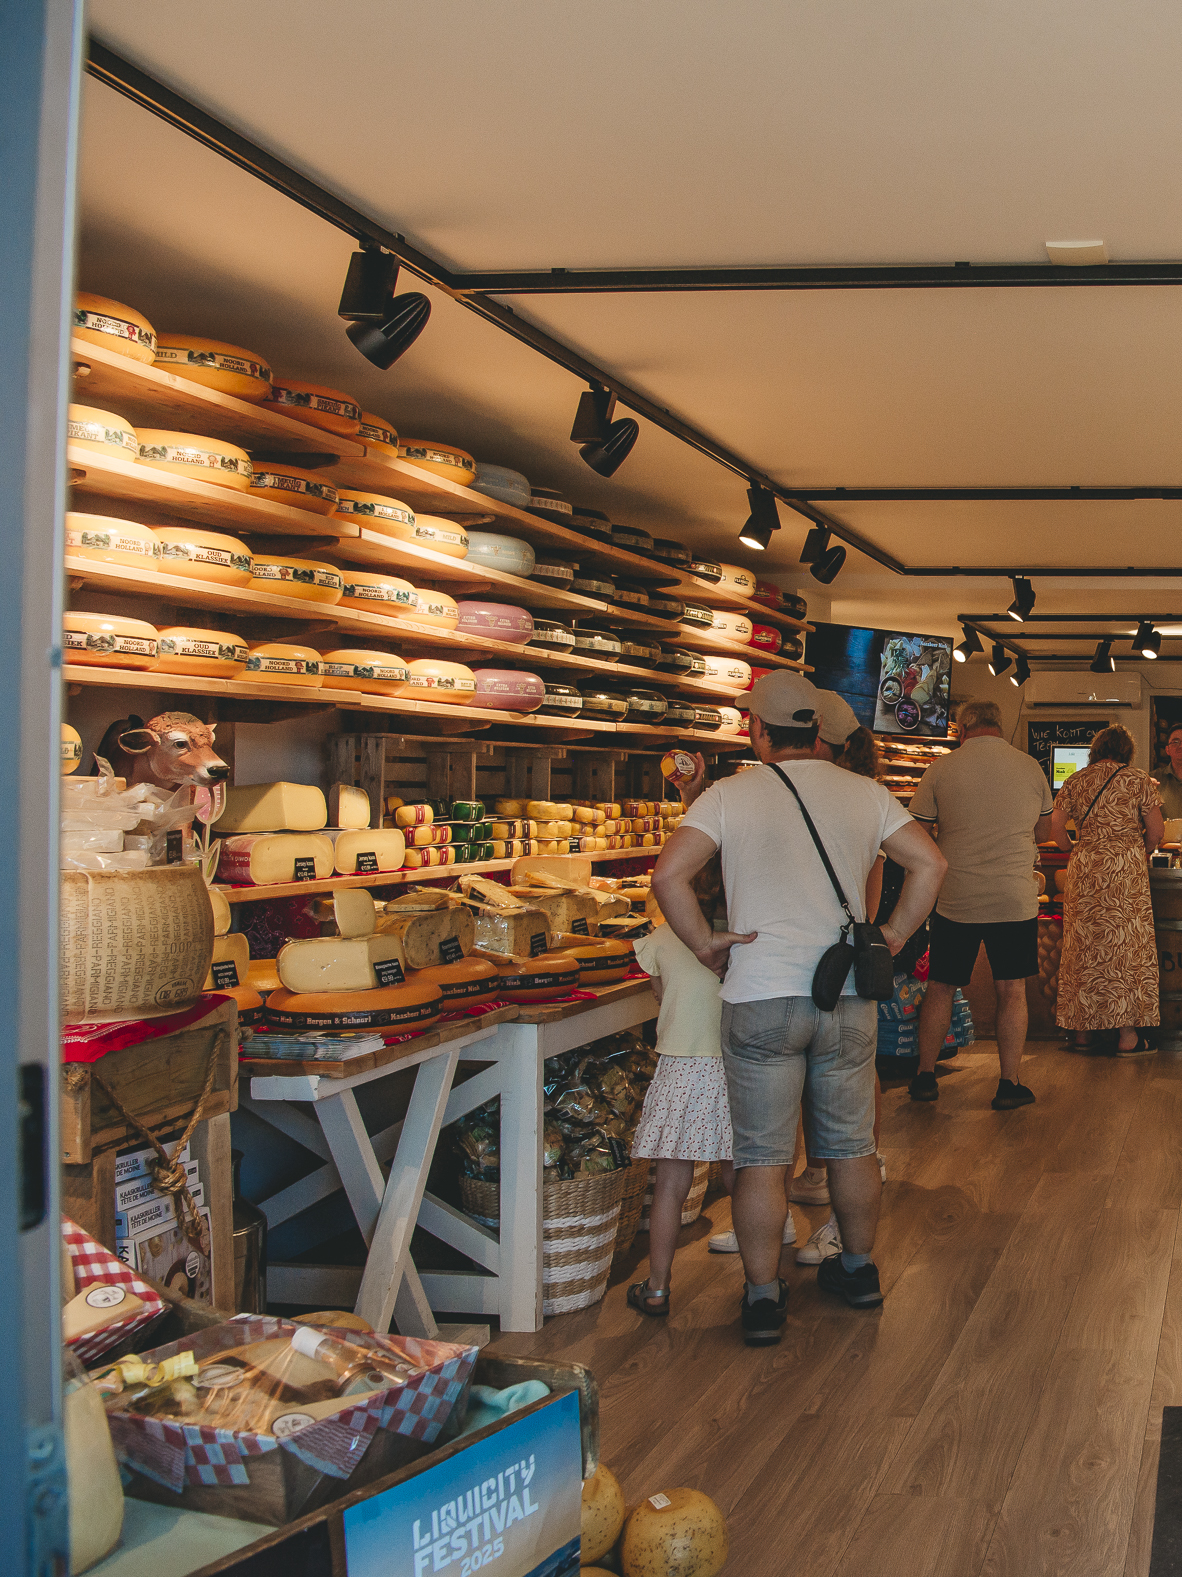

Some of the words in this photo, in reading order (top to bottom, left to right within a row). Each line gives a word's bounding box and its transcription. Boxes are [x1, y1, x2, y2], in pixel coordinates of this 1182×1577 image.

[223, 357, 245, 367] NOORD
[219, 363, 248, 373] HOLLAND
[172, 456, 205, 465] HOLLAND
[119, 538, 142, 546] NOORD
[443, 534, 457, 542] MILD
[115, 543, 144, 553] HOLLAND
[195, 553, 229, 564] KLASSIEK
[207, 550, 223, 558] OUD
[123, 639, 145, 647] NOORD
[119, 645, 147, 653] HOLLAND
[181, 648, 217, 656] KLASSIEK
[1031, 728, 1051, 739] WIE
[1056, 725, 1086, 739] KOMT
[1086, 729, 1099, 737] ON
[442, 987, 467, 996] aasboer
[390, 1011, 419, 1021] Kaasboer
[306, 1017, 332, 1026] Bergen
[115, 1158, 139, 1171] SKRULLER
[124, 1163, 141, 1175] MOINE
[119, 1182, 152, 1199] KAASKRULLE
[132, 1193, 140, 1203] DE
[130, 1204, 161, 1223] KAASKRULLER
[141, 1216, 148, 1226] DE
[147, 1210, 162, 1224] MOINE
[412, 1453, 536, 1551] LIQUICITY
[413, 1487, 539, 1577] FESTIVAL
[460, 1536, 505, 1577] 2025
